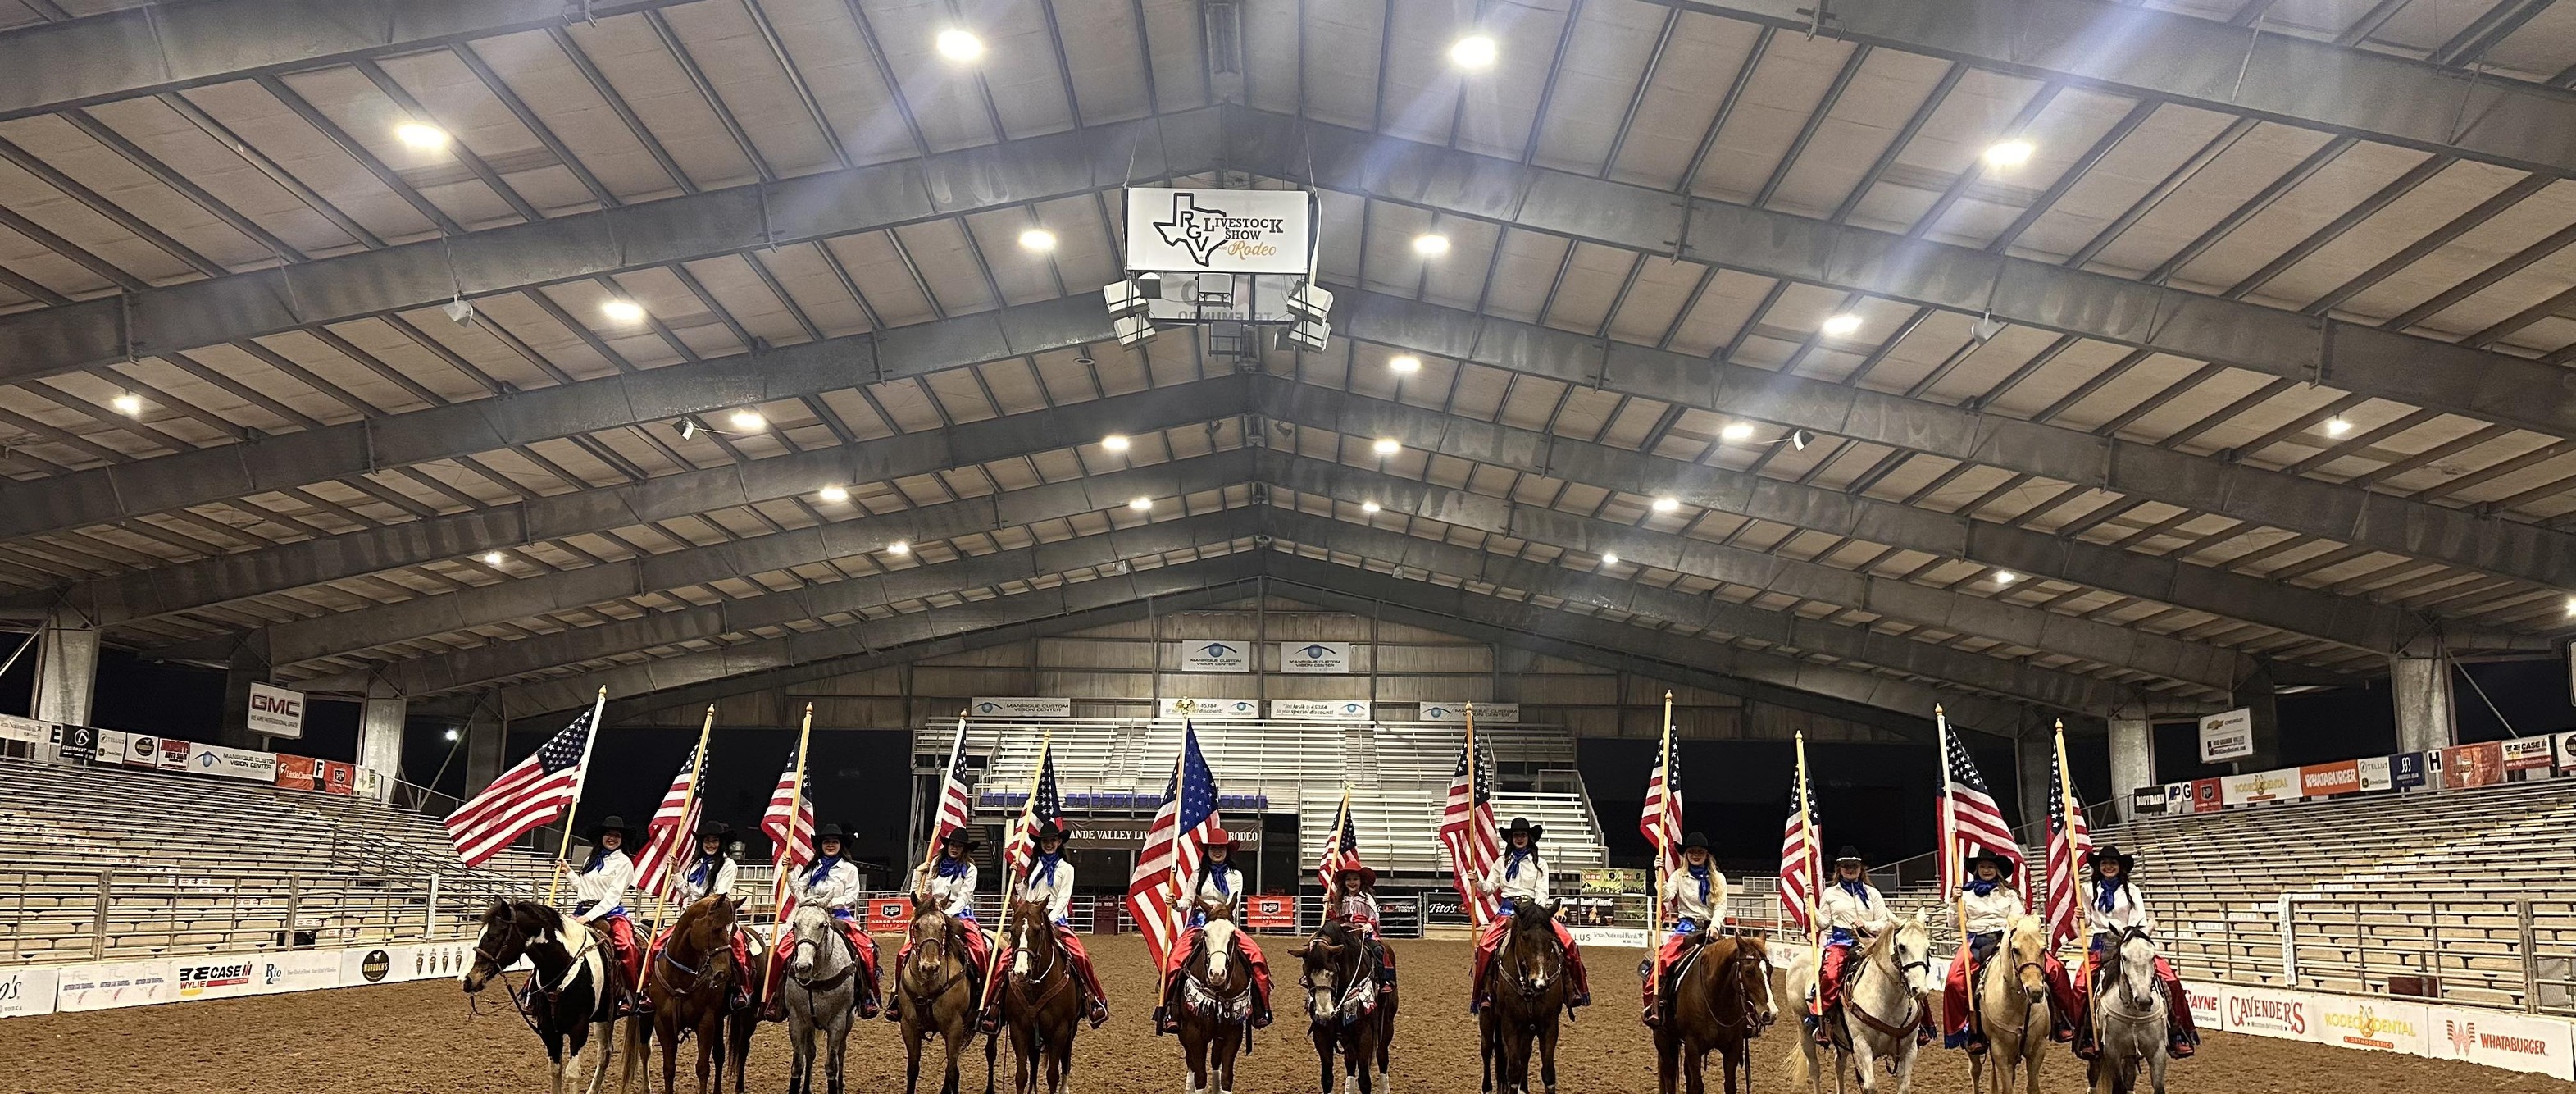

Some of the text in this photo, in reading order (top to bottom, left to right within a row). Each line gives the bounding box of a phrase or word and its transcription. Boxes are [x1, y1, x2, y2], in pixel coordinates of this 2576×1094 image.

[1204, 217, 1283, 234] LIVESTOCK
[1225, 230, 1261, 240] SHOW
[1228, 241, 1277, 260] Rodeo
[251, 694, 301, 718] GMC
[2521, 741, 2540, 750] CASE
[250, 762, 271, 770] CENTER
[2429, 752, 2442, 770] H
[316, 762, 323, 776] F
[2305, 768, 2357, 788] WHATABURGER
[2183, 784, 2191, 799] G
[1069, 830, 1095, 840] ANDE
[1096, 831, 1131, 840] VALLEY
[1228, 832, 1258, 841] RODEO
[885, 906, 899, 915] HP
[1263, 904, 1277, 912] HP
[1428, 902, 1457, 914] Tito's
[1574, 933, 1591, 941] LUS
[210, 965, 242, 979] CASE
[266, 964, 281, 979] Rio
[180, 981, 205, 990] WYLIE
[2230, 996, 2305, 1035] CAVENDER'S
[2324, 1013, 2416, 1037] RODEO DENTAL
[2480, 1033, 2546, 1056] WHATABURGER
